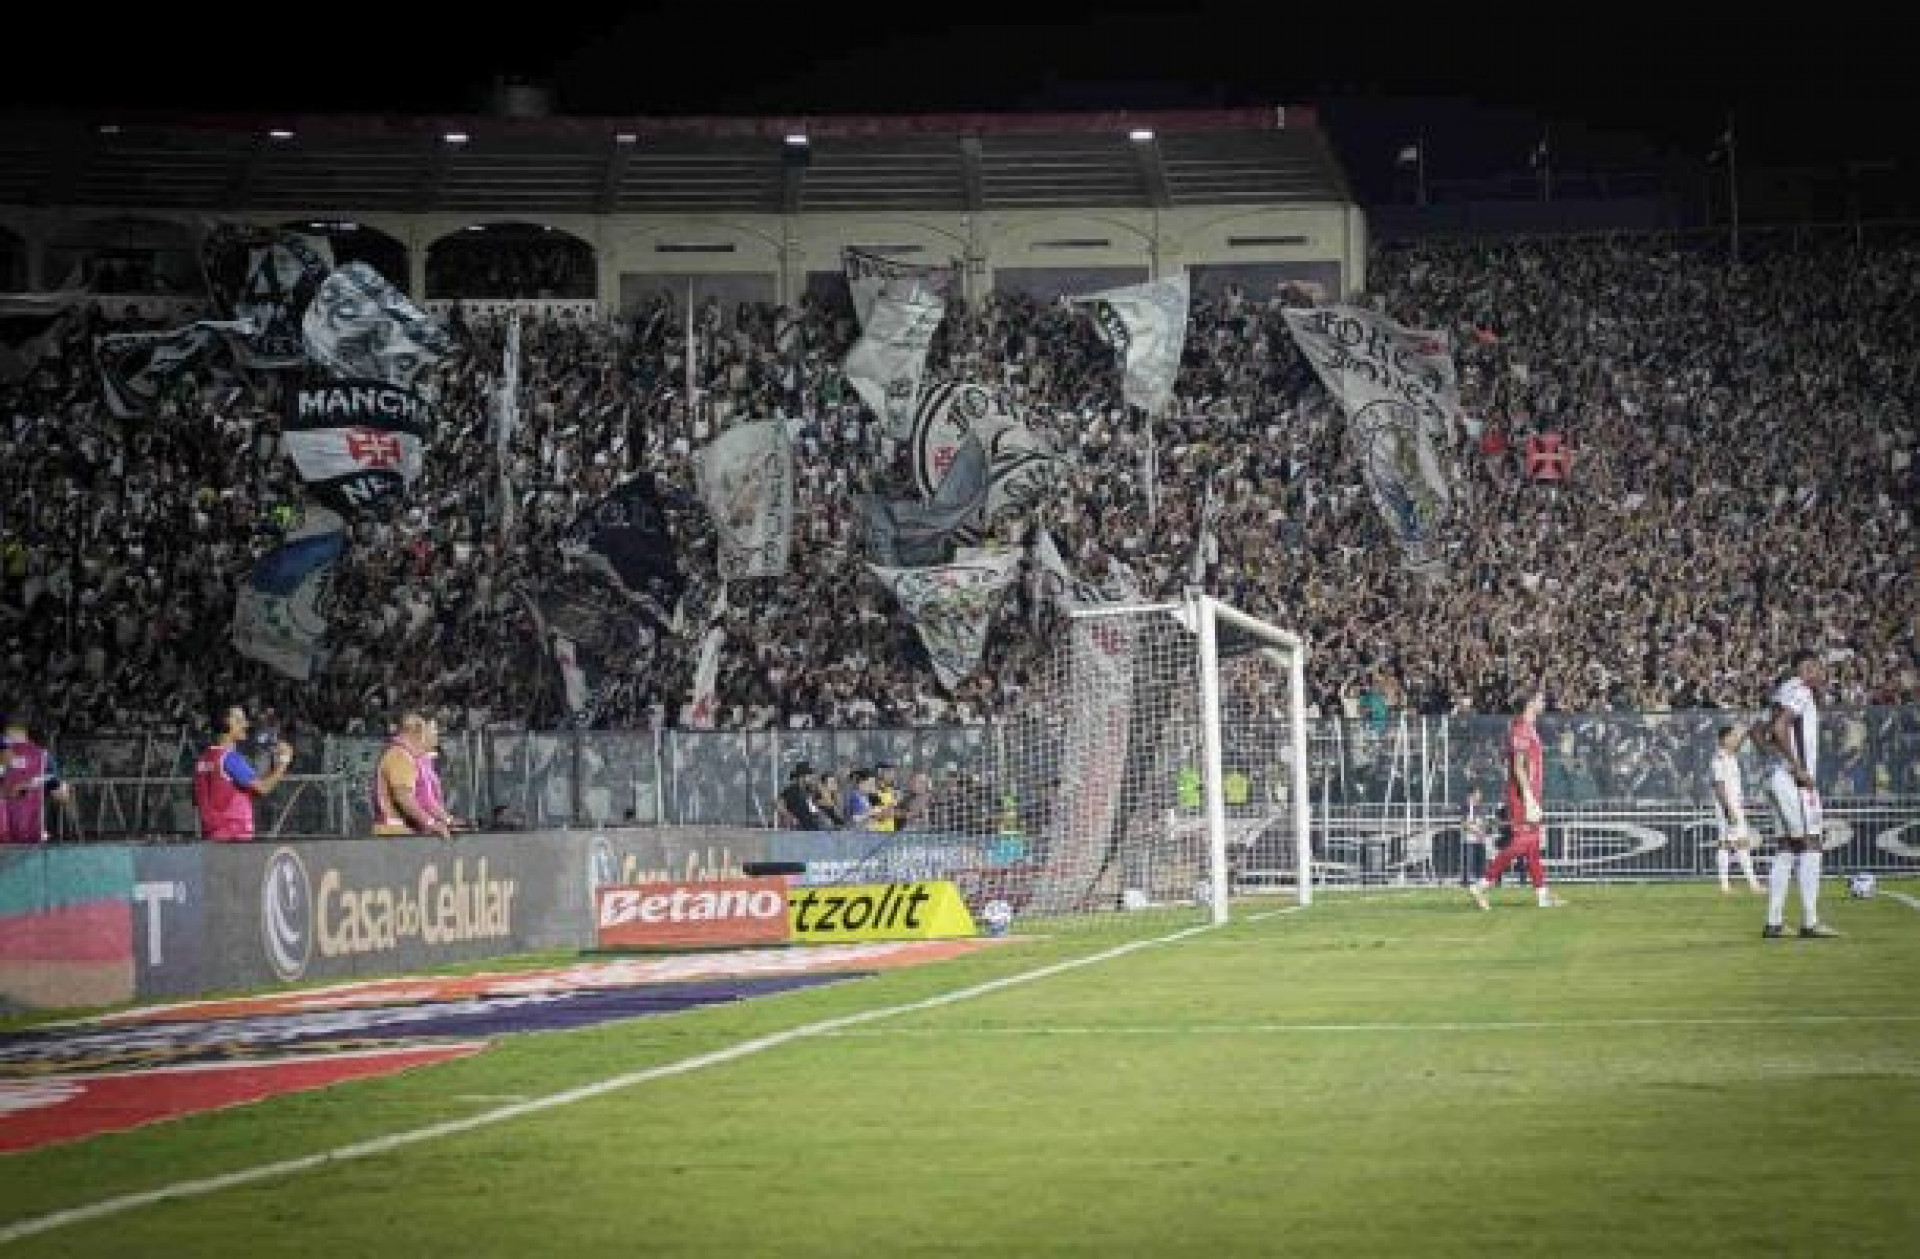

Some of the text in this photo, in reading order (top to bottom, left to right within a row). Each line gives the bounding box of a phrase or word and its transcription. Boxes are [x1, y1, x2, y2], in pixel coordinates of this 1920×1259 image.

[317, 868, 396, 957] Casa
[418, 856, 514, 945] Celular
[600, 887, 784, 927] Betano
[789, 883, 929, 932] tzolit
